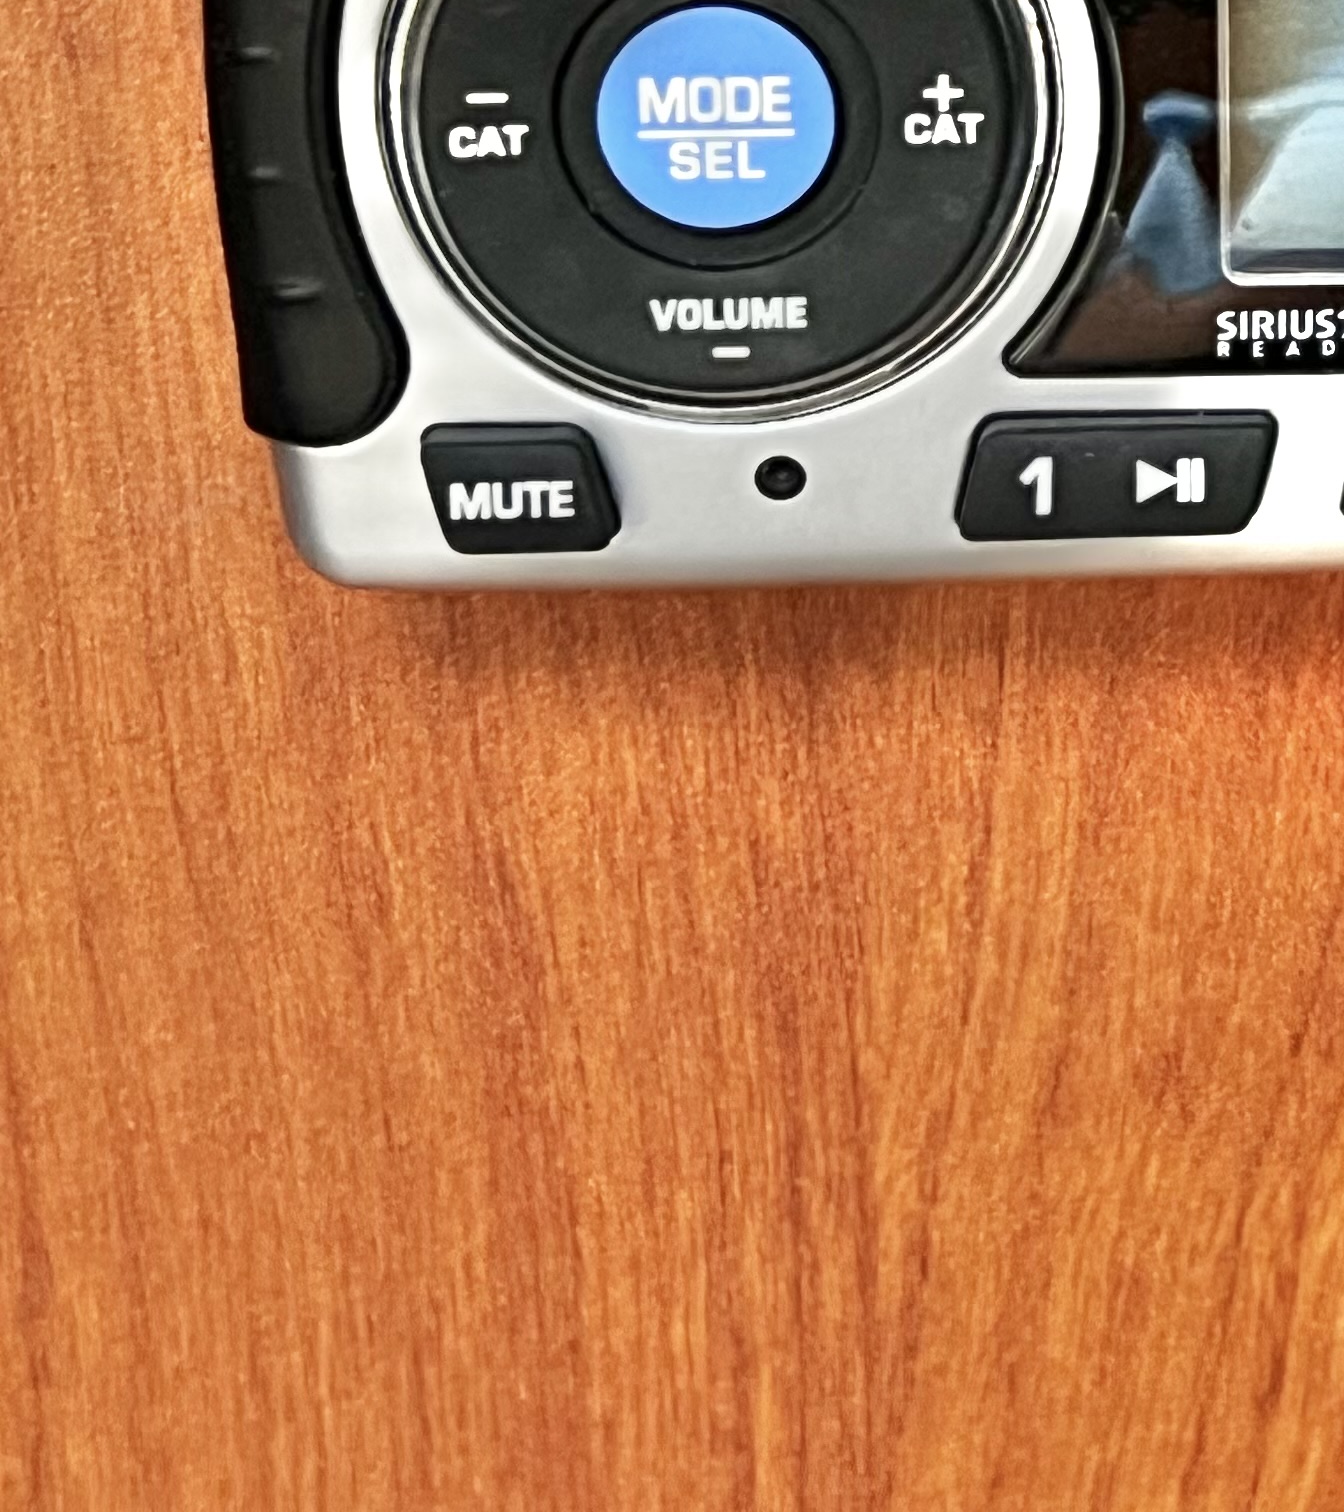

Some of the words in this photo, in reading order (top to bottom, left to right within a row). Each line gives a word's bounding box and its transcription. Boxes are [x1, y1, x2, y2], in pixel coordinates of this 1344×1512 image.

[636, 74, 793, 127] MODE
[448, 124, 530, 159] CAT
[903, 112, 985, 145] CAT
[669, 141, 766, 180] SEL
[648, 296, 808, 332] VOLUME
[1216, 308, 1337, 341] SIRIUS
[449, 480, 576, 521] MUTE
[1019, 456, 1053, 516] 1
